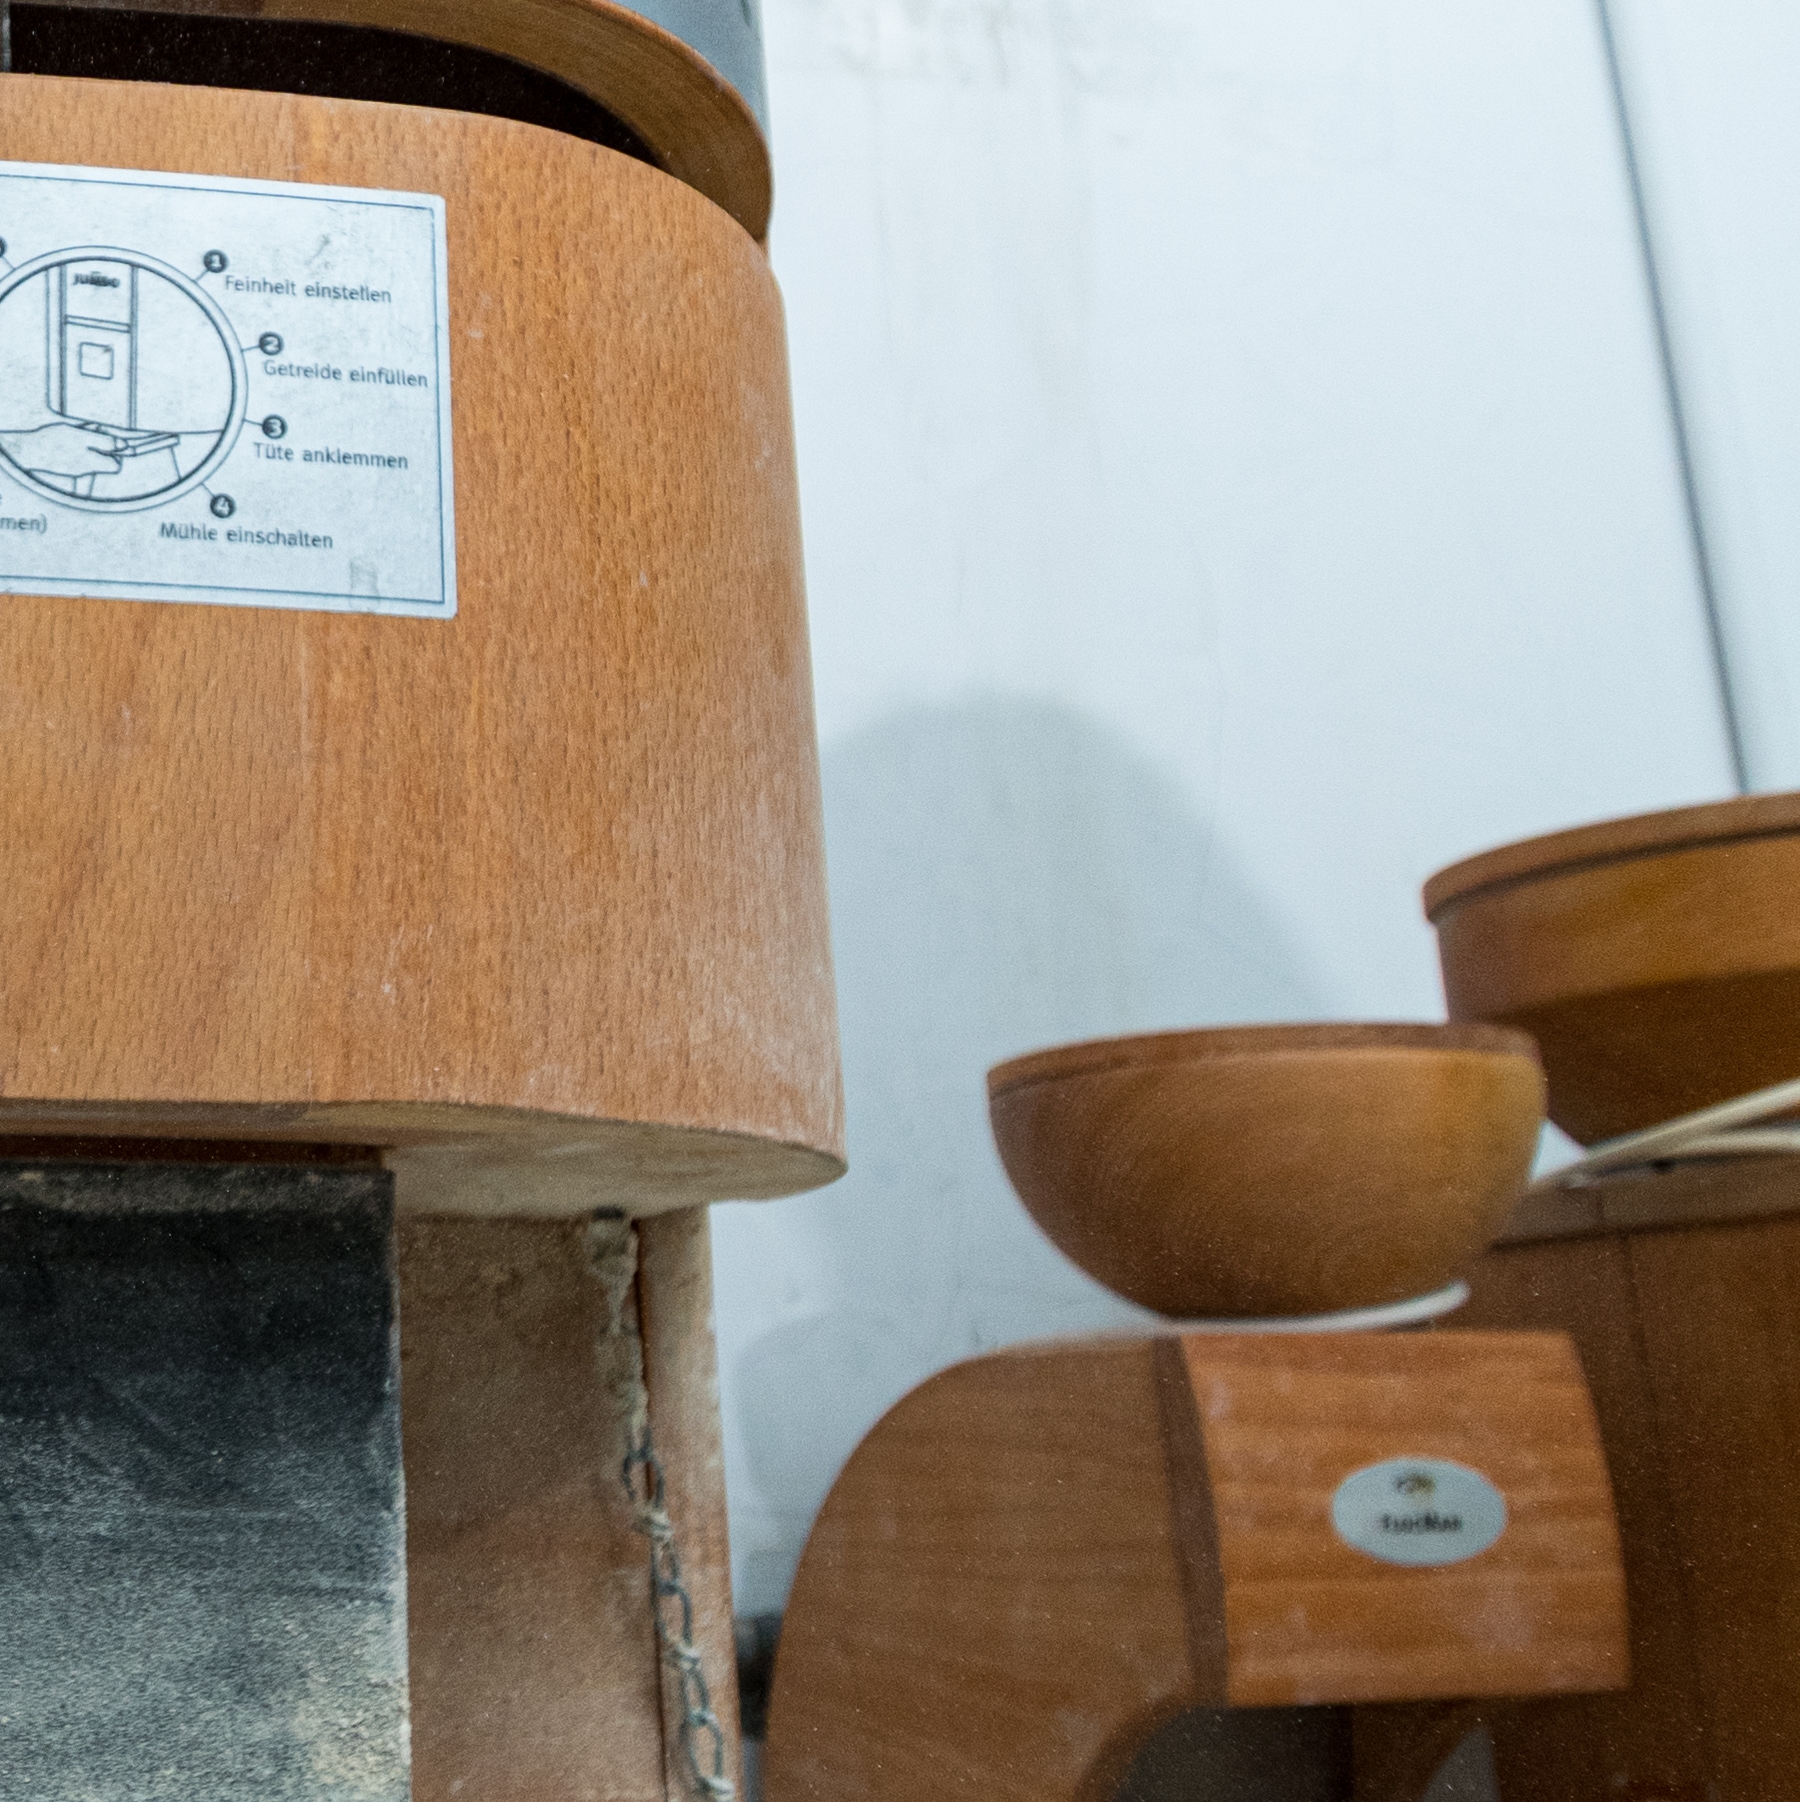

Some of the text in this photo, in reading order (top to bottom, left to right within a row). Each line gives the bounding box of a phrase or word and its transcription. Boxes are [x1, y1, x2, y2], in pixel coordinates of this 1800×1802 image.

[226, 275, 392, 303] Feinheit einstellen
[263, 359, 428, 387] Getreide einfüllen
[253, 441, 409, 469] Tüte anklemmen
[160, 522, 334, 548] Mühle einschalten
